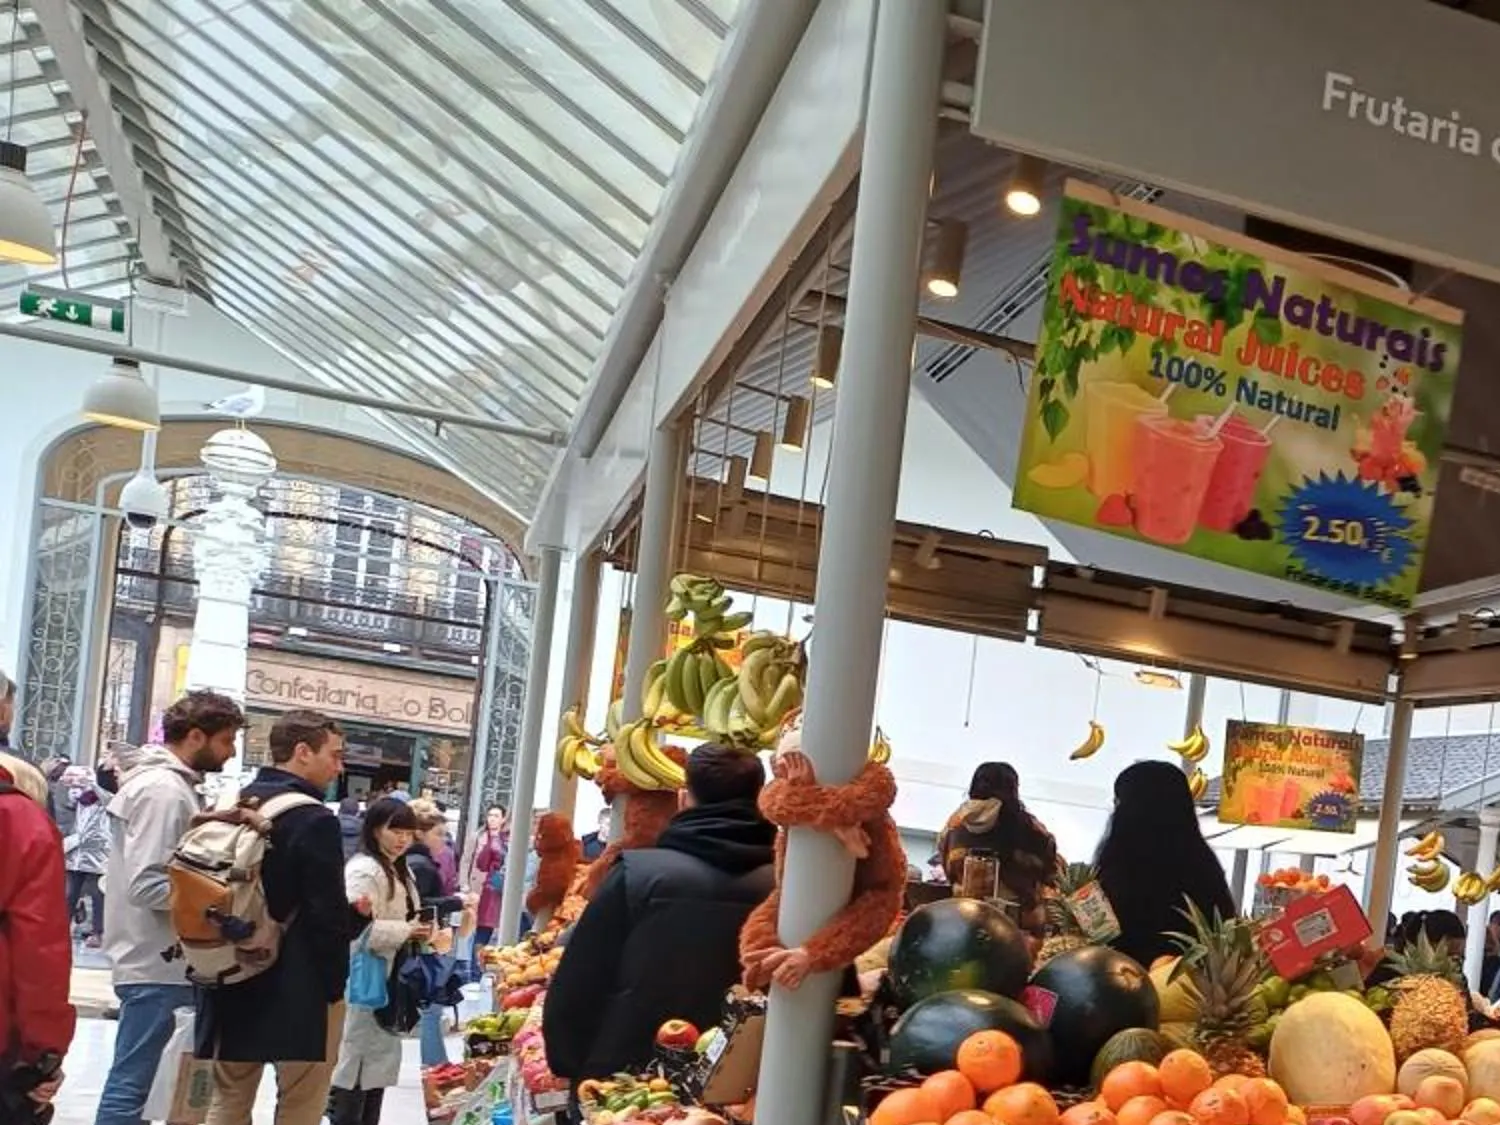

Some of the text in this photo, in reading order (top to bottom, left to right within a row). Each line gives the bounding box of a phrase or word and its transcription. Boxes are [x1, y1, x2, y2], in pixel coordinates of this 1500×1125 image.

[1322, 71, 1481, 156] Frutaria
[1069, 212, 1448, 372] Sumos Naturais
[1060, 270, 1366, 400] Natural Juices
[1149, 351, 1340, 431] 100% Natural
[246, 668, 377, 714] Confeitaria
[428, 695, 475, 724] Bol
